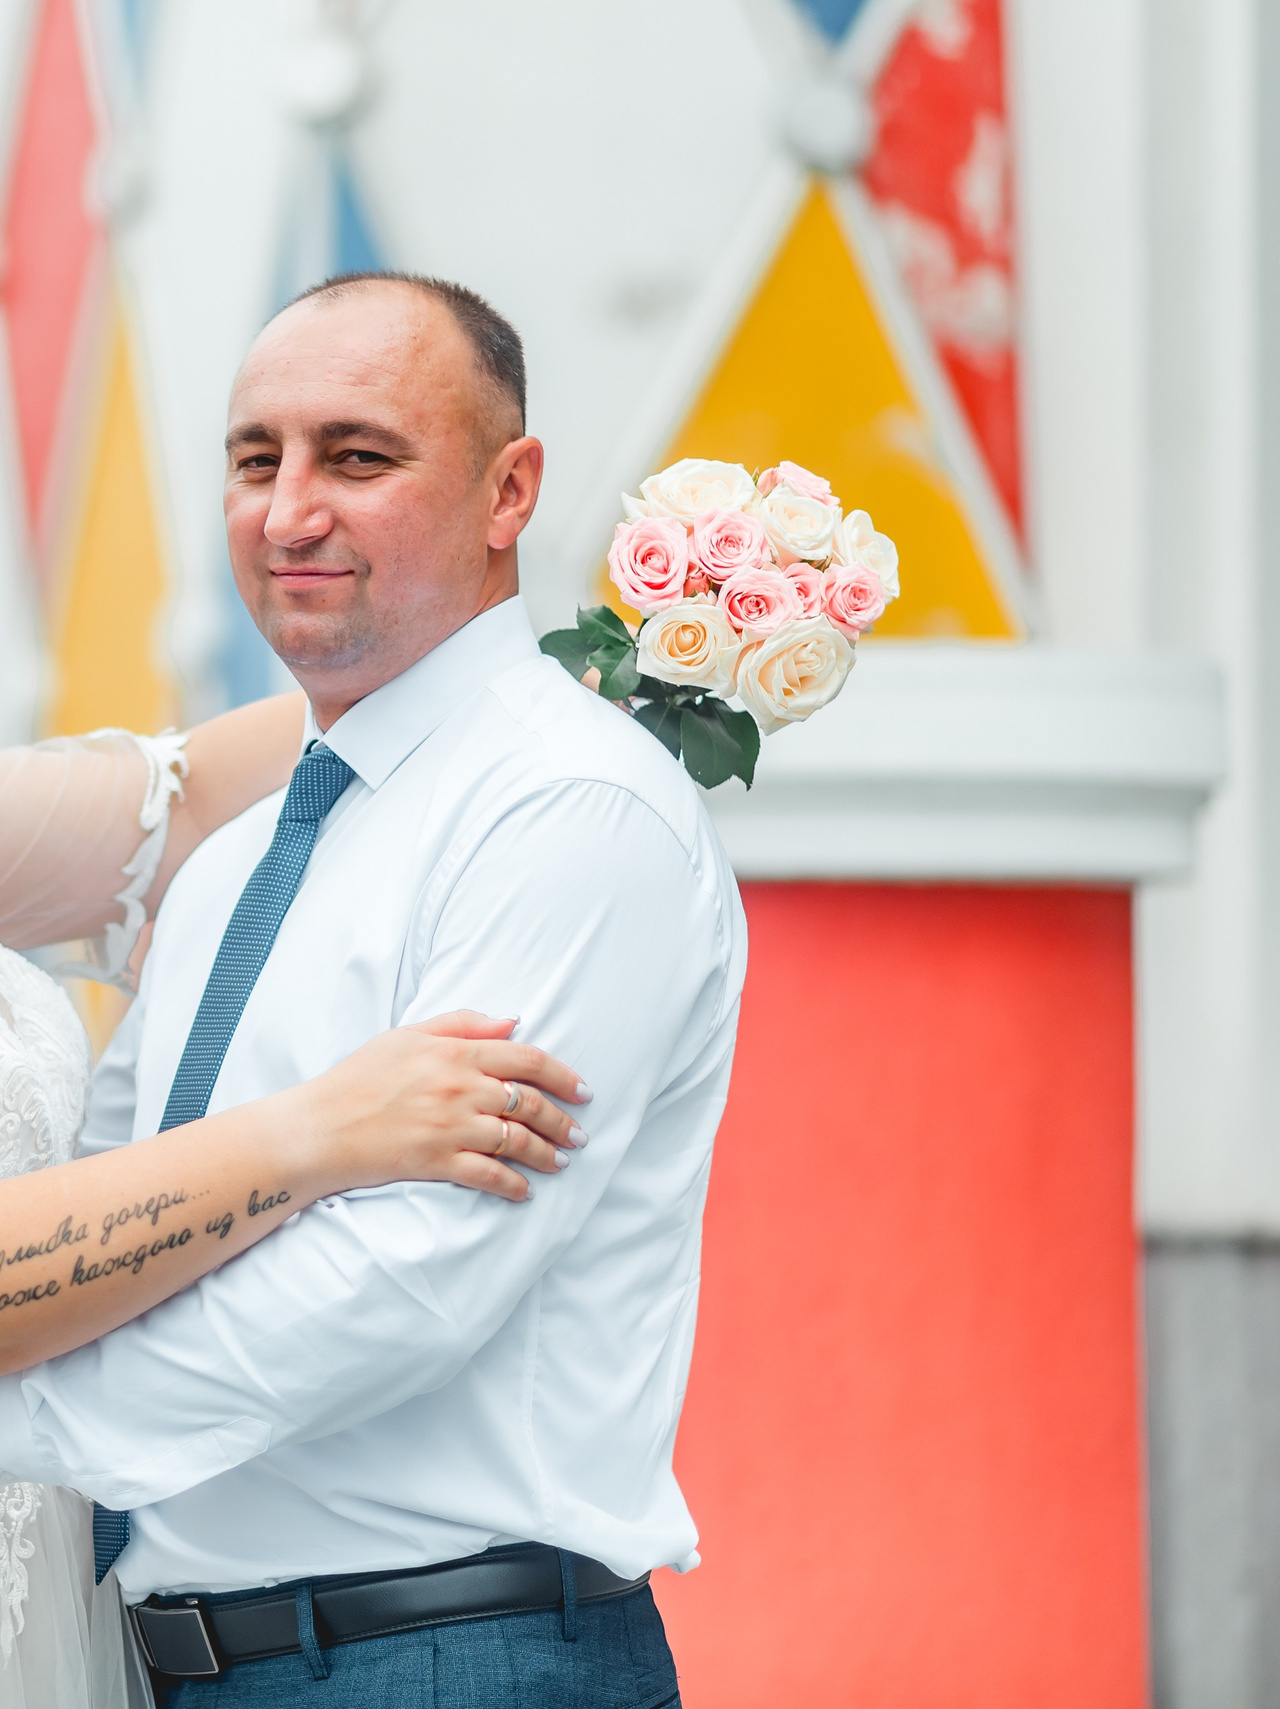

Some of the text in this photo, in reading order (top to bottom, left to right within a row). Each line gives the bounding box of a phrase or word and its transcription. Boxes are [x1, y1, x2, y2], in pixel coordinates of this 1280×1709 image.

[70, 1227, 194, 1285] каждого
[205, 1211, 235, 1239] из
[247, 1189, 292, 1217] вас
